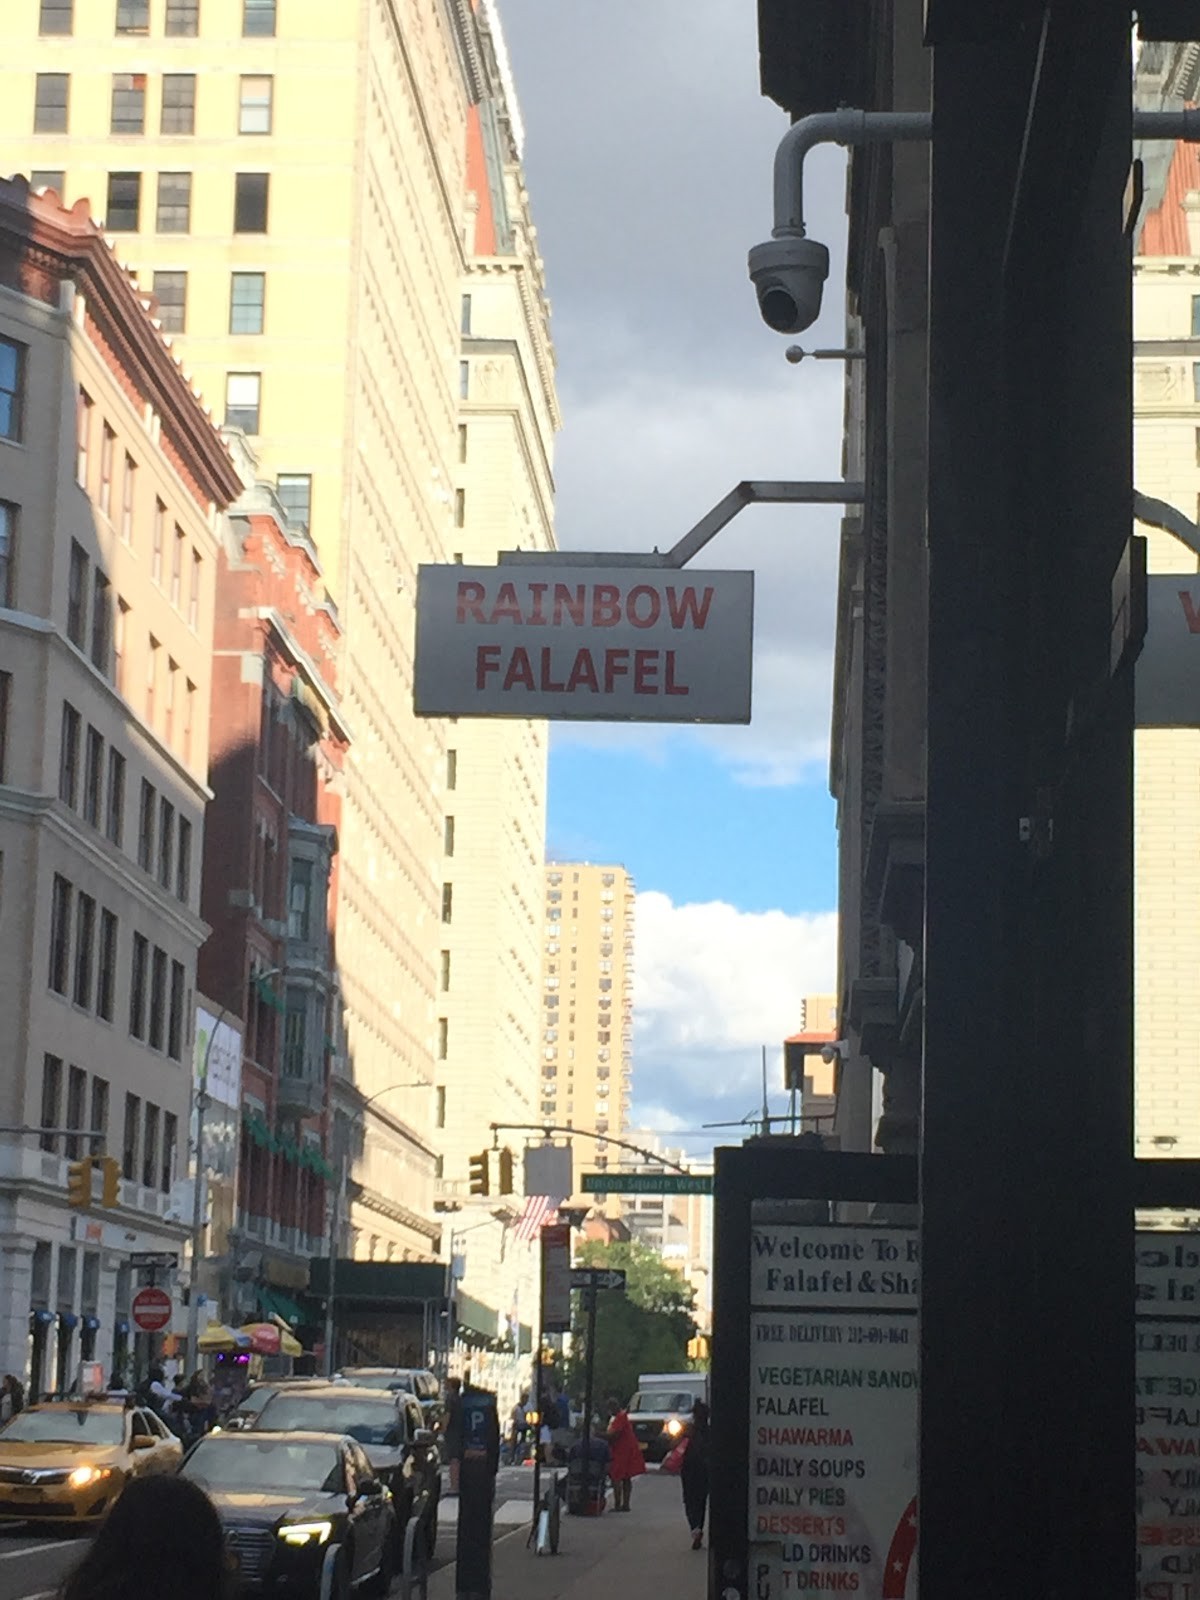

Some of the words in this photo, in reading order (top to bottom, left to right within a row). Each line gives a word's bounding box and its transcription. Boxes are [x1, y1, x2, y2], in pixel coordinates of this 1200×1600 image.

[456, 580, 714, 630] RAINBOW
[476, 645, 690, 696] FALAFEL
[585, 1178, 623, 1189] Union
[627, 1178, 674, 1191] Square
[676, 1178, 707, 1191] West
[753, 1235, 865, 1261] Welcome
[871, 1237, 899, 1263] To
[757, 1366, 863, 1388] VEGETARIAN
[756, 1396, 830, 1416] FALAFEL
[471, 1410, 485, 1432] P
[757, 1426, 854, 1447] SHAWARMA
[757, 1457, 804, 1478] DAILY
[808, 1458, 866, 1479] SOUPS
[757, 1486, 805, 1506] DAILY
[808, 1486, 847, 1507] PIES
[757, 1515, 847, 1536] DESSERTS
[782, 1543, 804, 1563] LD
[808, 1544, 872, 1565] DRINKS
[797, 1570, 860, 1591] DRINKS
